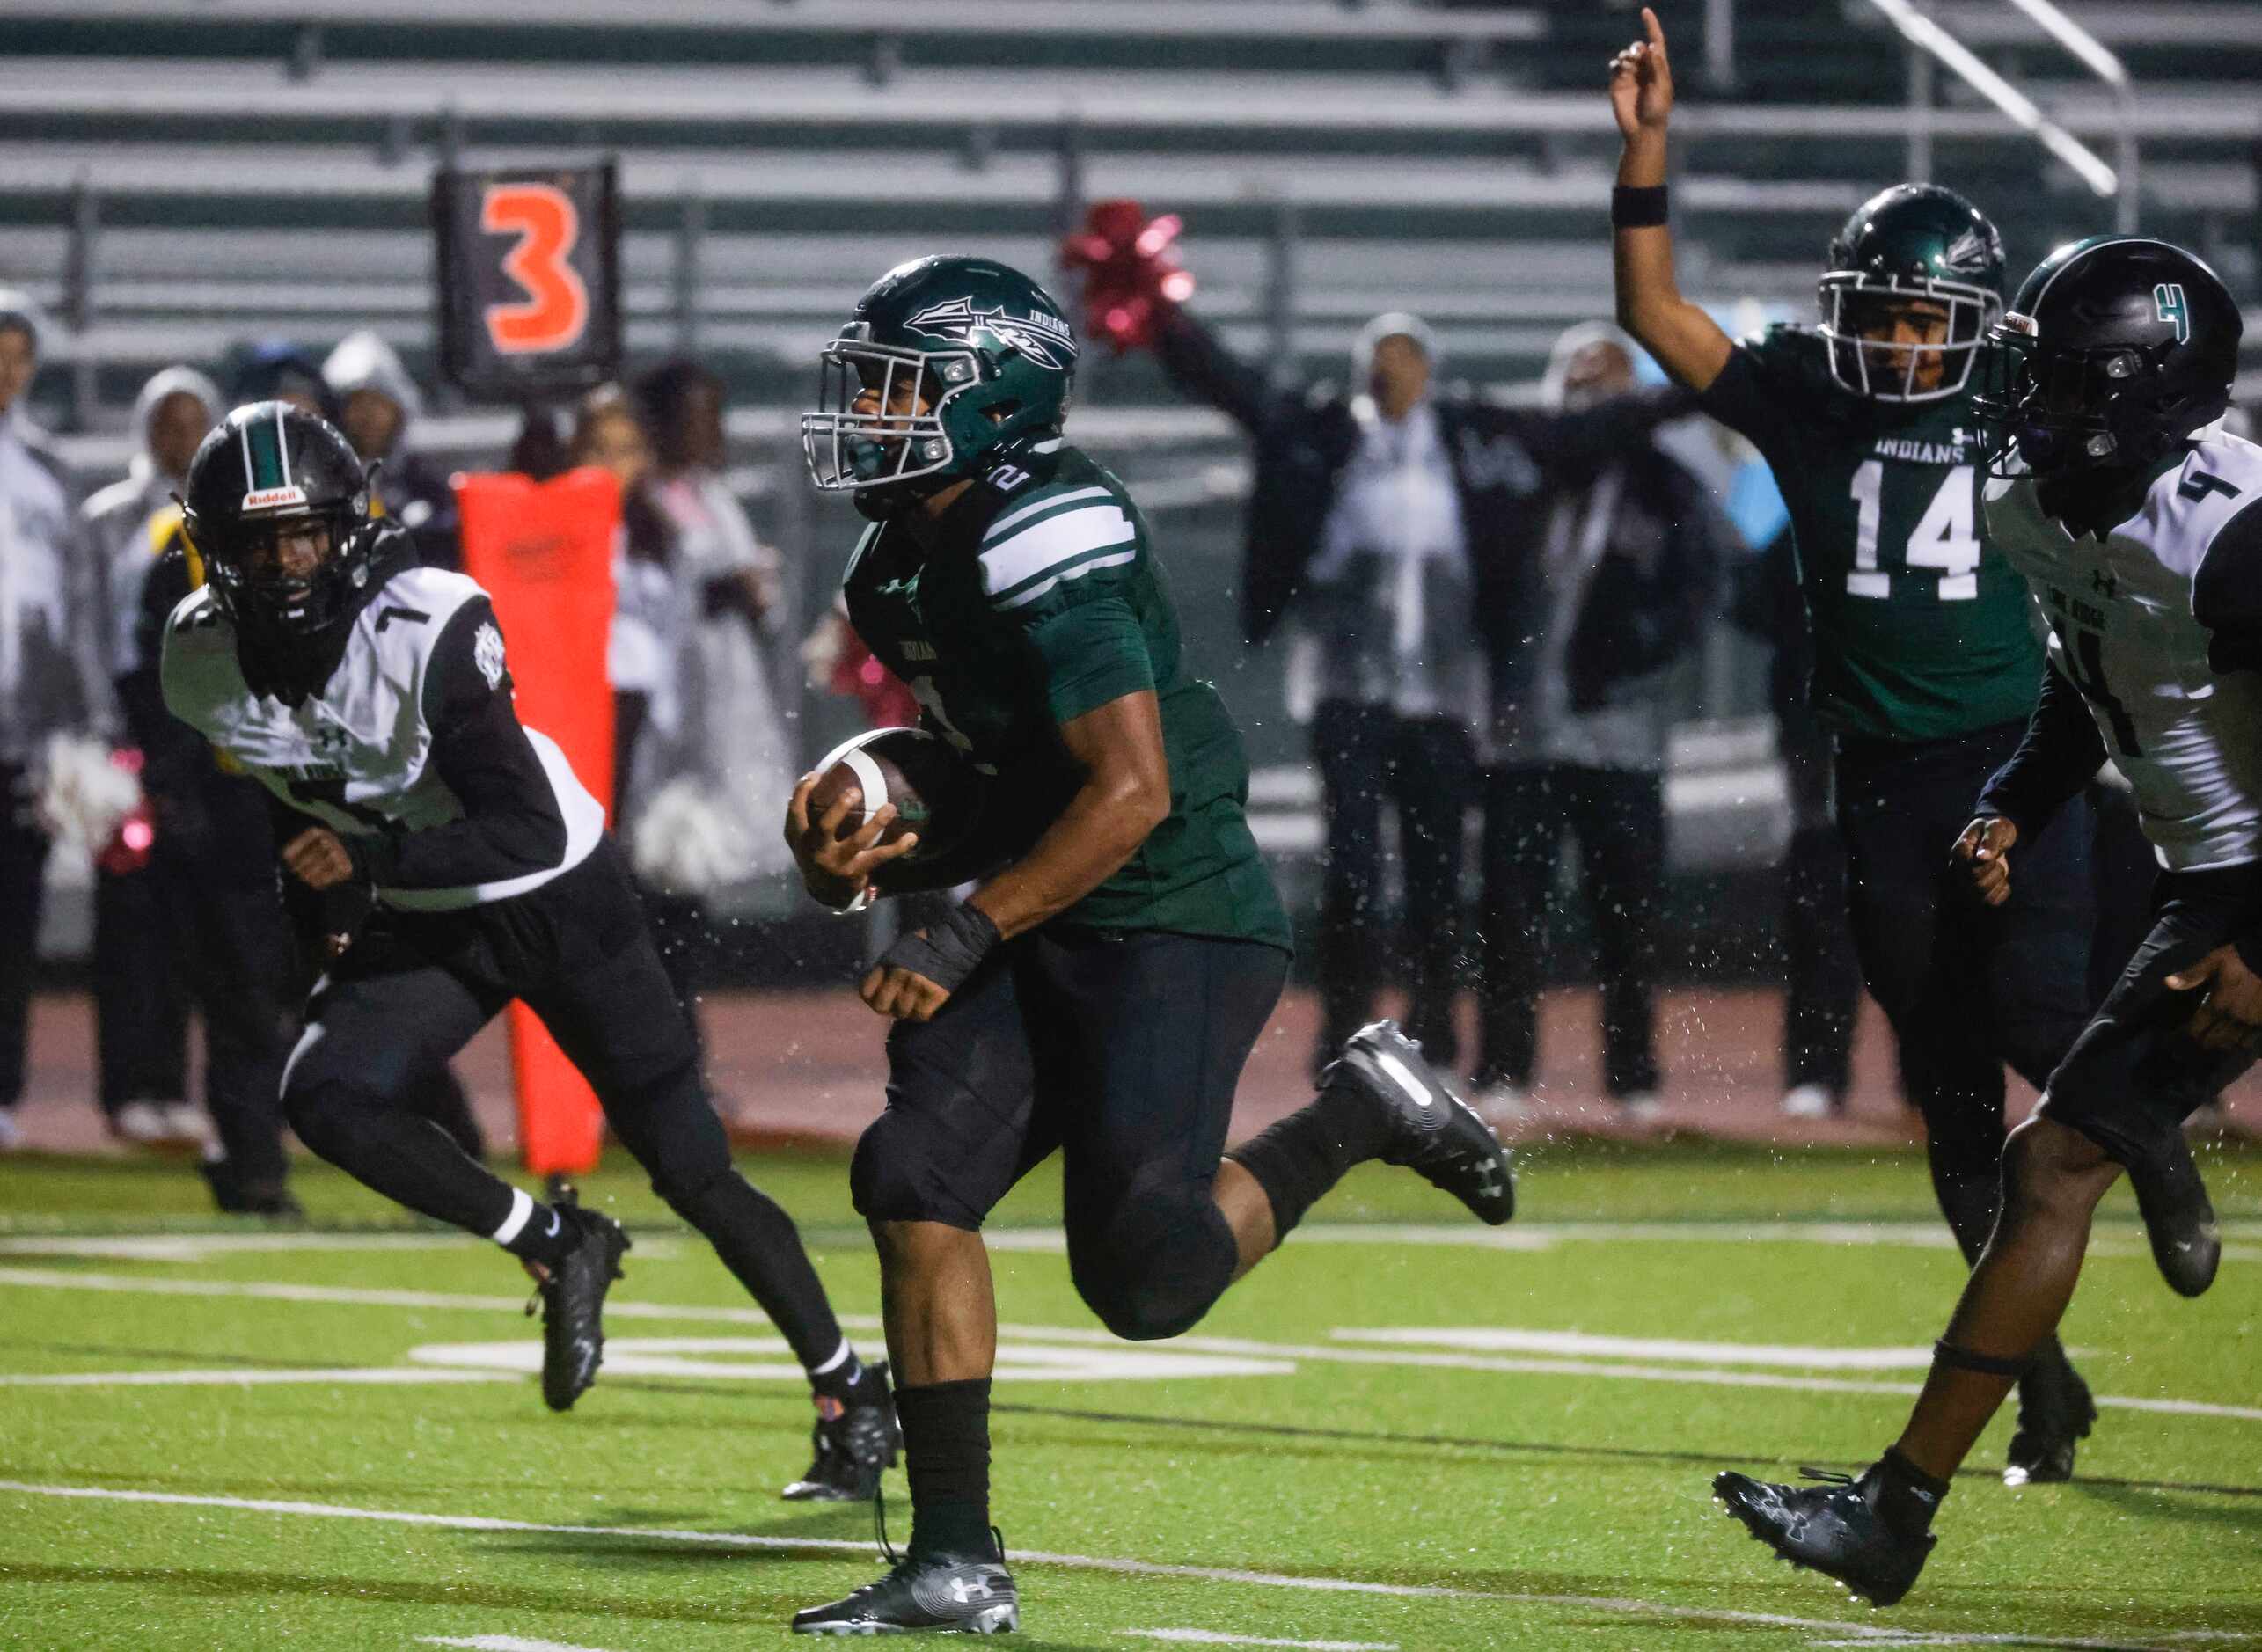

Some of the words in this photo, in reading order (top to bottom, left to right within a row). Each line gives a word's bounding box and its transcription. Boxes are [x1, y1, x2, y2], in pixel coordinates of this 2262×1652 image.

[480, 181, 590, 355] 3
[1029, 309, 1071, 338] INDIANS
[2154, 284, 2190, 345] 4
[1874, 438, 1966, 464] INDIANS
[986, 464, 1030, 491] 2
[2177, 470, 2243, 504] 4
[248, 492, 296, 506] Riddell
[1847, 460, 1980, 601] 14
[375, 606, 431, 632] 7
